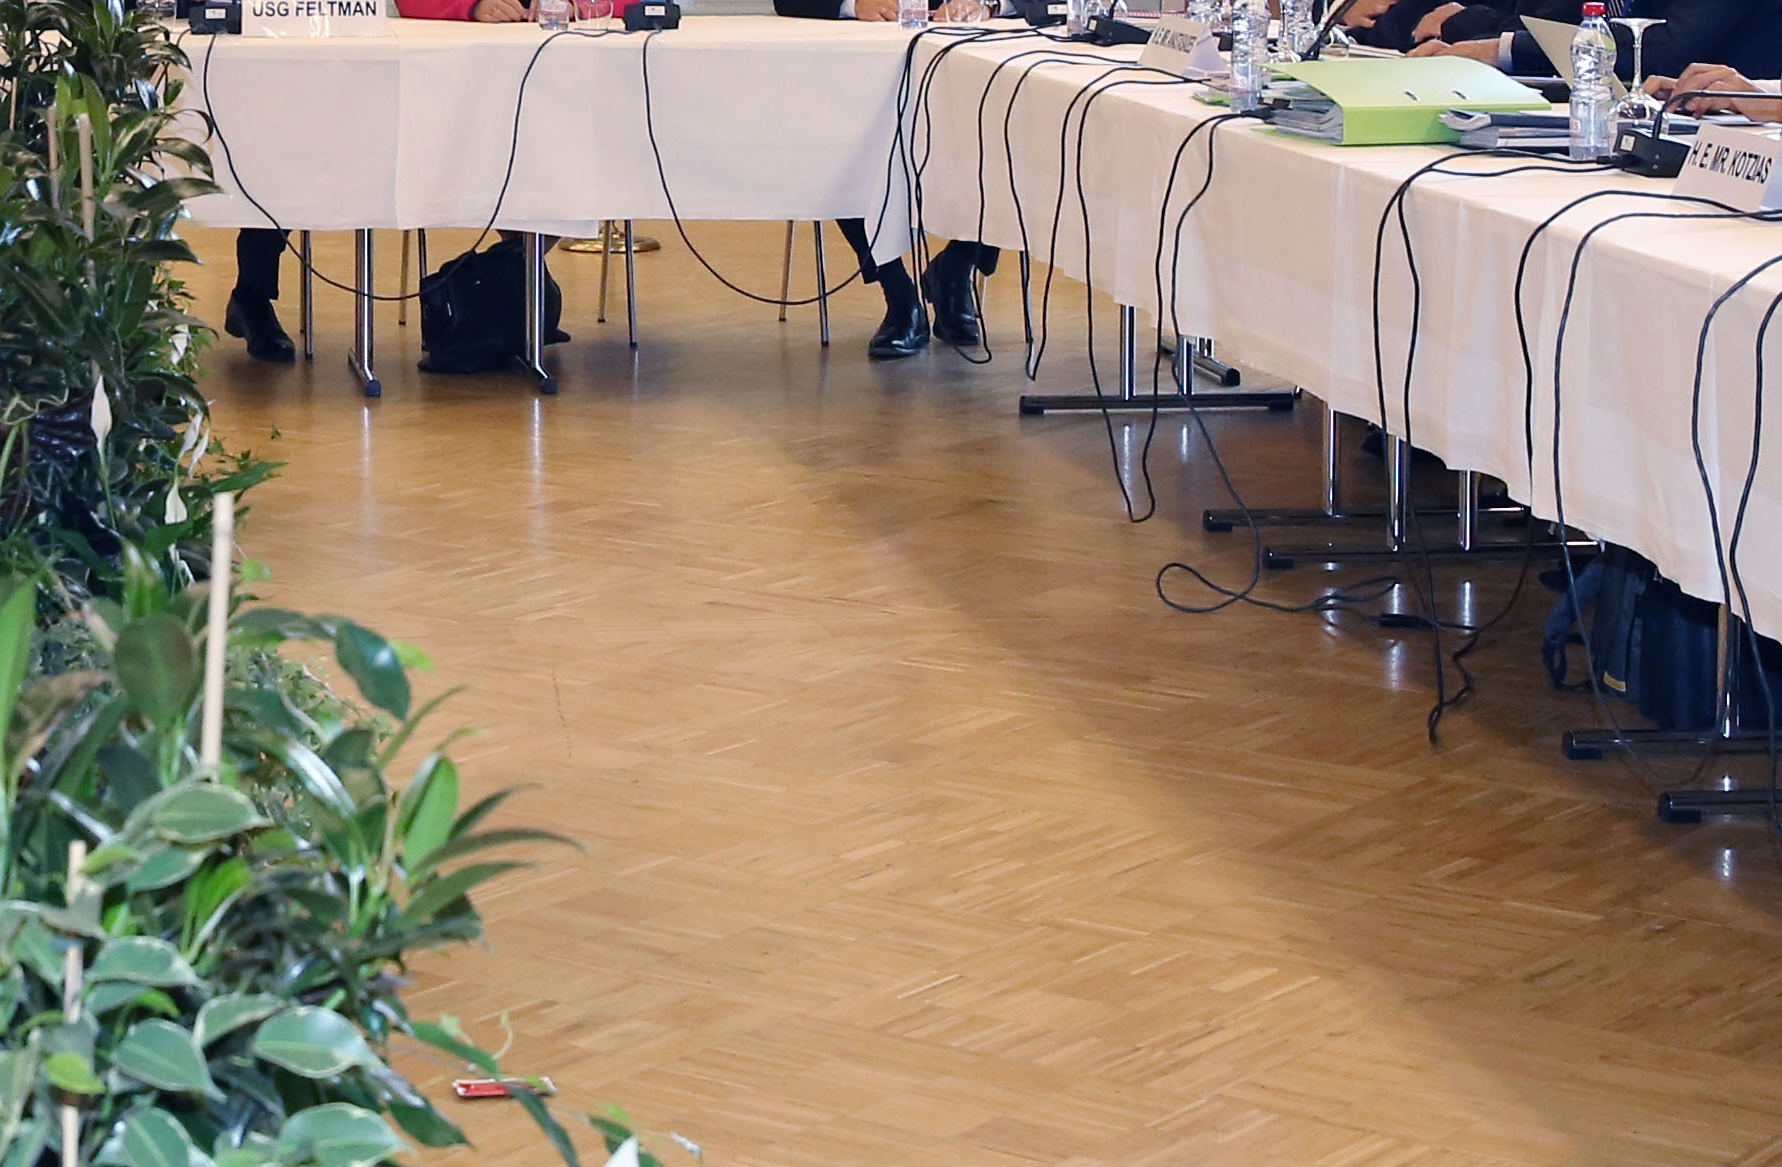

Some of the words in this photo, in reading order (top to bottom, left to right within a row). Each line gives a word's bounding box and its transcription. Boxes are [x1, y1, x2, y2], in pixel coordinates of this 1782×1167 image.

[252, 0, 289, 17] USG
[295, 0, 377, 17] FELTMAN
[1709, 145, 1730, 173] MR.
[1727, 149, 1773, 184] KOTZIAS
